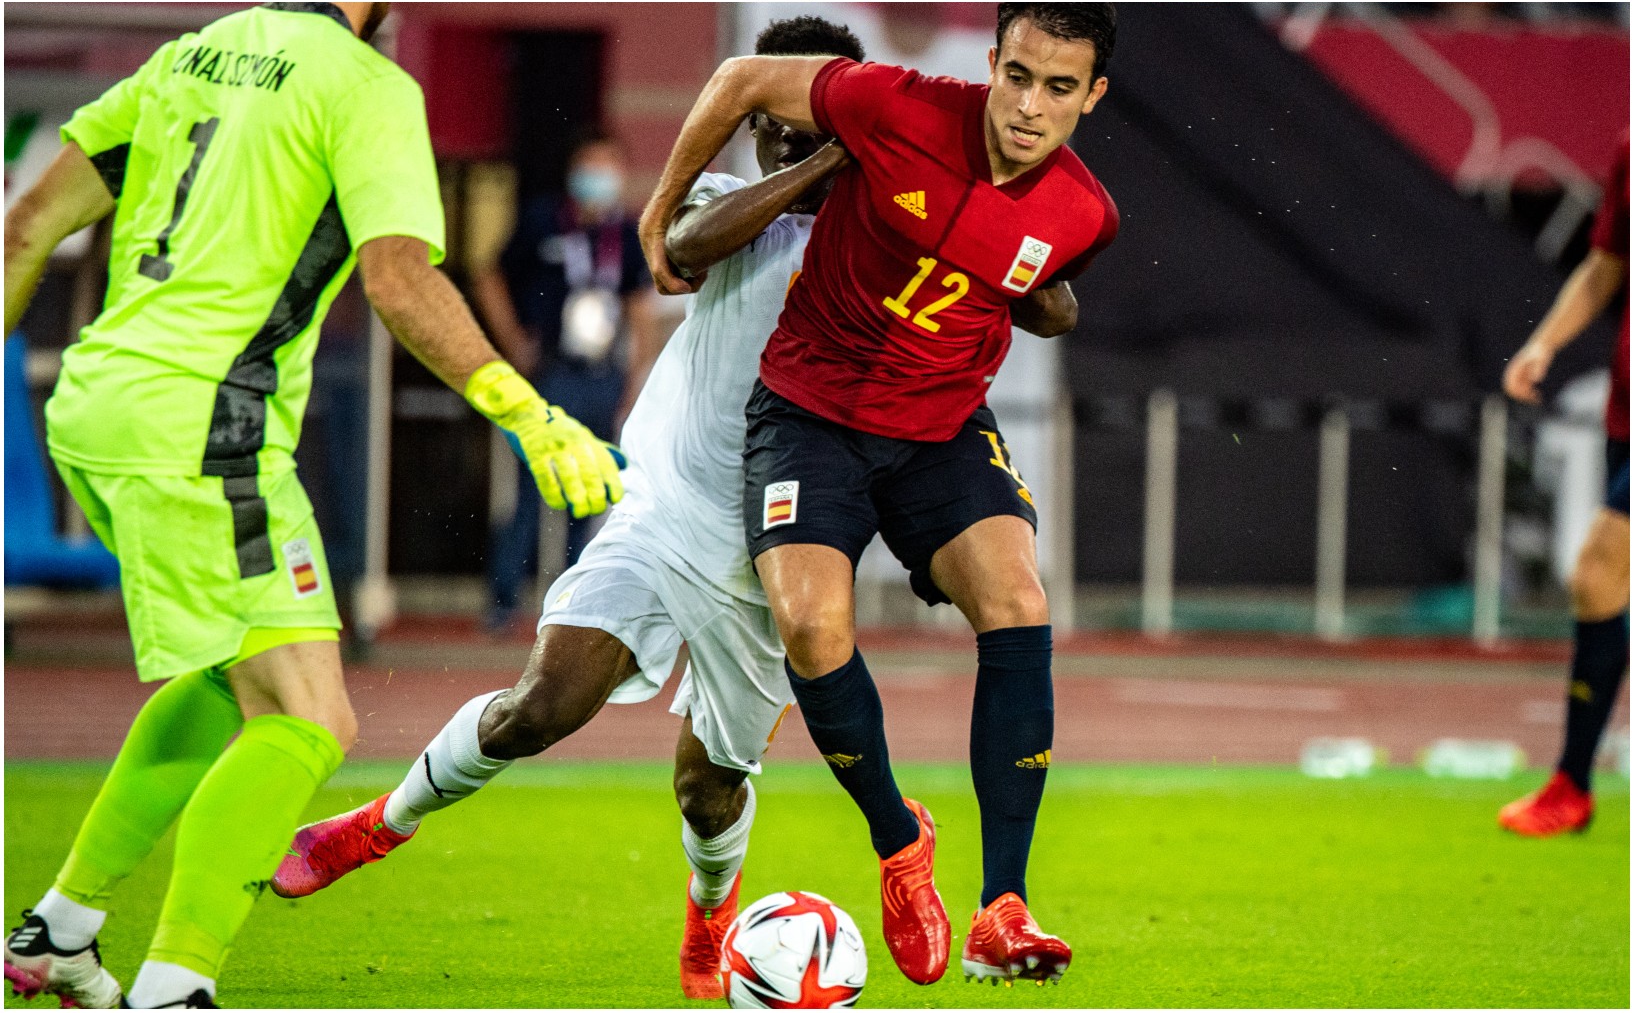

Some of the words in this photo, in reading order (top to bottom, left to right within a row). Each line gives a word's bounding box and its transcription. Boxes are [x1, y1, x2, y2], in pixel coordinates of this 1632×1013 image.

[137, 116, 221, 283] 1
[892, 194, 929, 220] adidas
[882, 256, 970, 333] 12
[1015, 760, 1050, 769] adid
